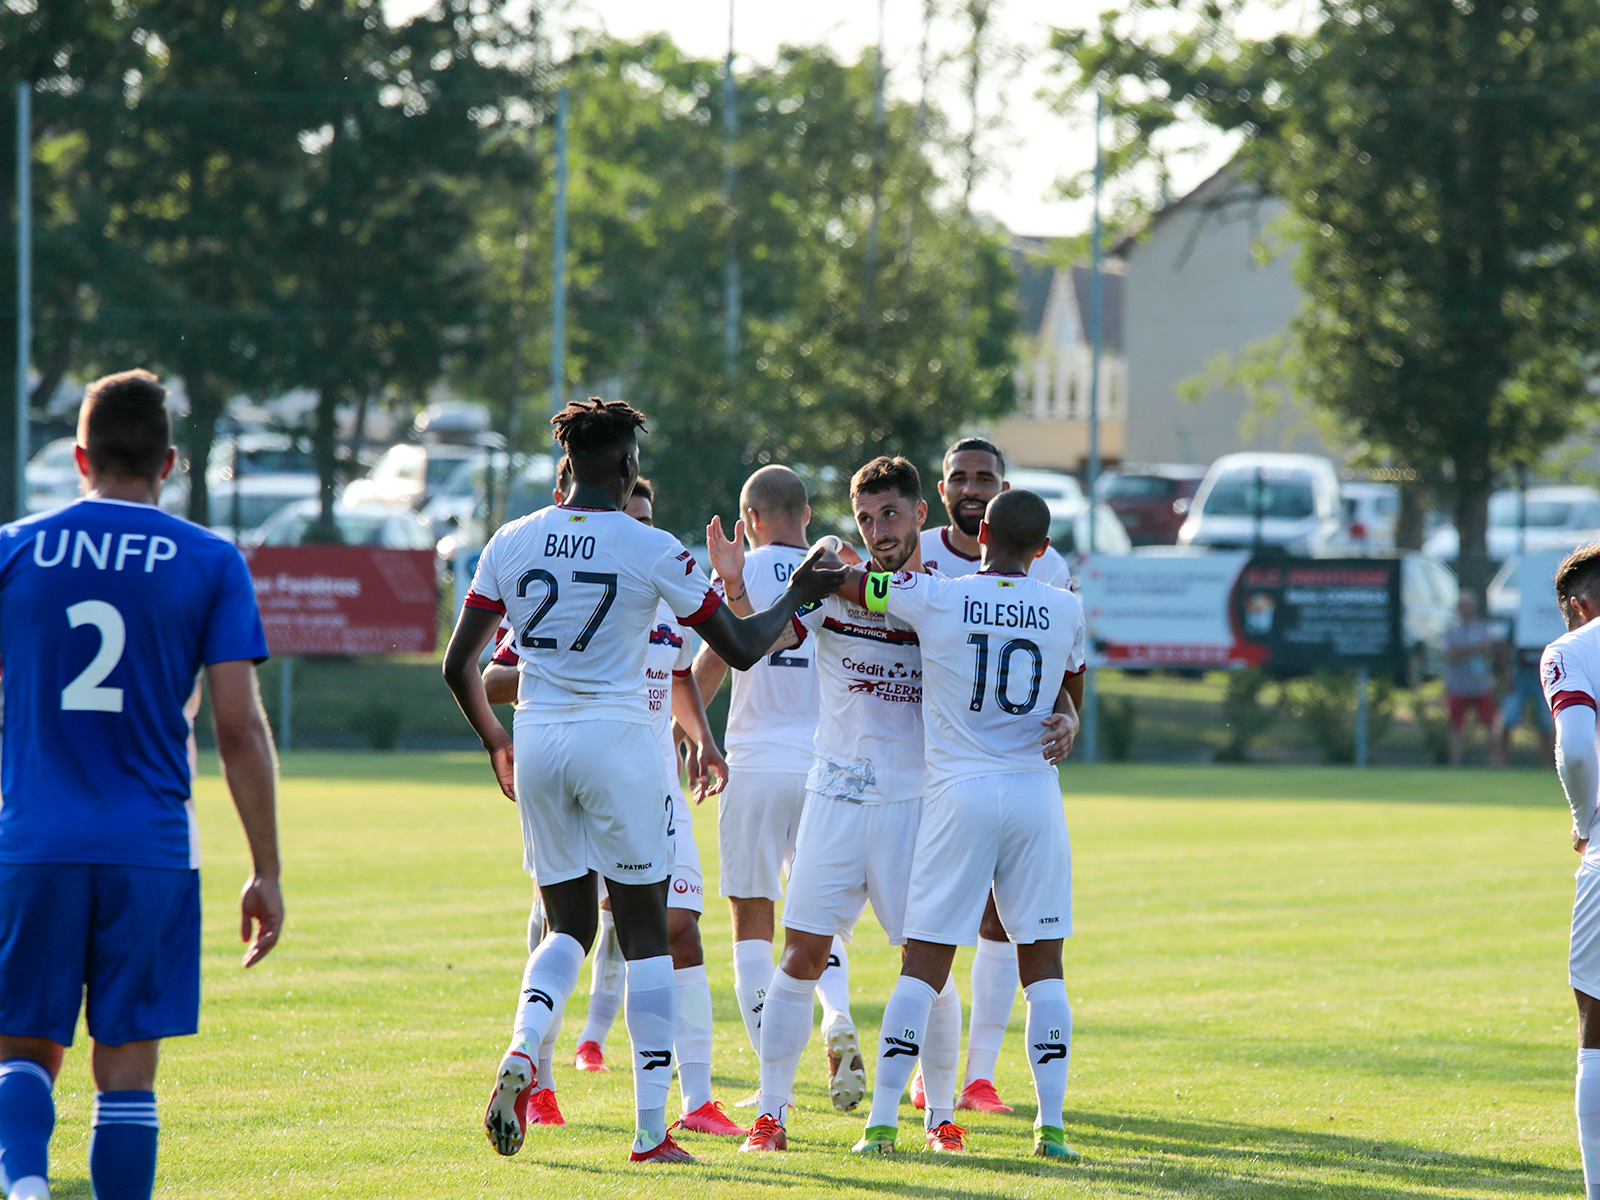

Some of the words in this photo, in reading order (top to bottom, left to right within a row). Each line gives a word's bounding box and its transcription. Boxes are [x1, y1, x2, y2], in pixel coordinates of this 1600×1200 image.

[33, 529, 178, 573] UNFP
[544, 533, 596, 560] BAYO
[516, 568, 618, 652] 27
[853, 627, 888, 639] PATRICK
[60, 599, 126, 713] 2
[842, 657, 885, 677] Crédit
[966, 632, 1043, 715] 10
[623, 861, 653, 871] PATRICK
[756, 988, 766, 999] 25
[903, 1028, 915, 1040] 10
[1049, 1029, 1060, 1040] 10
